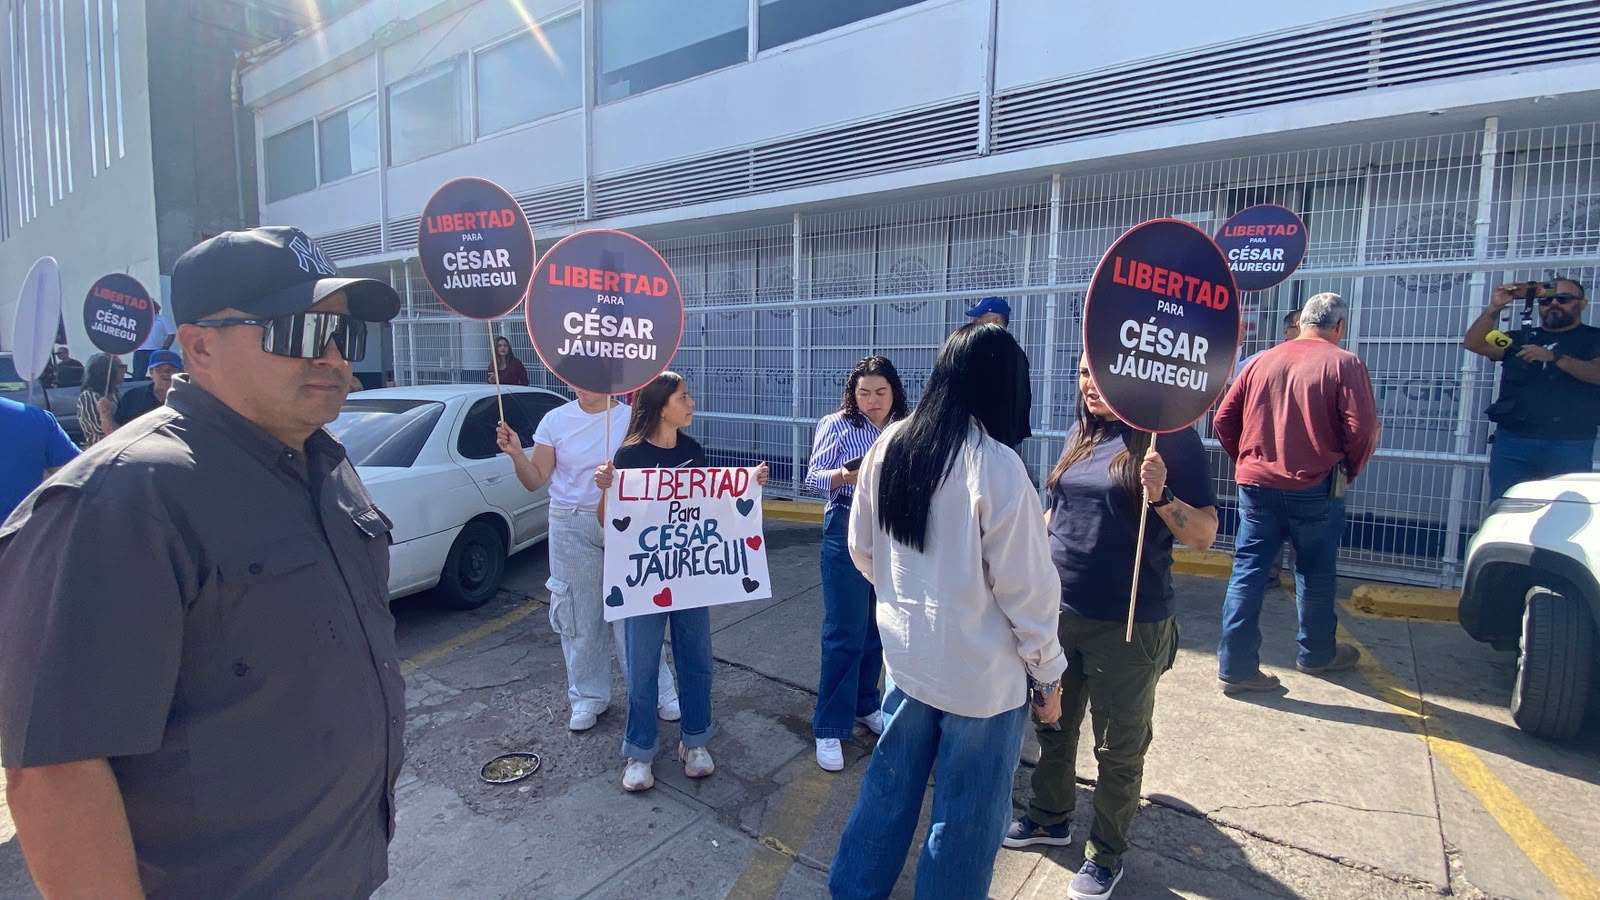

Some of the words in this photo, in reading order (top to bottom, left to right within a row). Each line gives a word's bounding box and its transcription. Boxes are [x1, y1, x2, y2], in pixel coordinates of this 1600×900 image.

[426, 208, 516, 234] LIBERTAD
[1224, 224, 1298, 237] LIBERTAD
[462, 233, 483, 242] PARA
[442, 246, 511, 271] CÉSAR
[1228, 245, 1285, 261] CÉSAR
[1228, 260, 1285, 272] ÁUREGUI
[443, 271, 517, 290] JÁUREGUI
[549, 263, 669, 297] LIBERTAD
[1113, 256, 1230, 311] LIBERTAD
[94, 286, 148, 310] LIBERTAD
[597, 294, 625, 306] PARA
[1157, 300, 1185, 317] PARA
[96, 309, 137, 331] CÉSAR
[563, 308, 654, 340] CÉSAR
[91, 321, 137, 342] JÁUREGUI
[1119, 317, 1209, 365] CÉSAR
[1495, 336, 1508, 348] 6
[557, 336, 657, 361] JÁUREGUI
[1109, 351, 1209, 392] JÁUREGUI
[618, 468, 748, 501] LIBERTAD
[668, 501, 700, 523] Para
